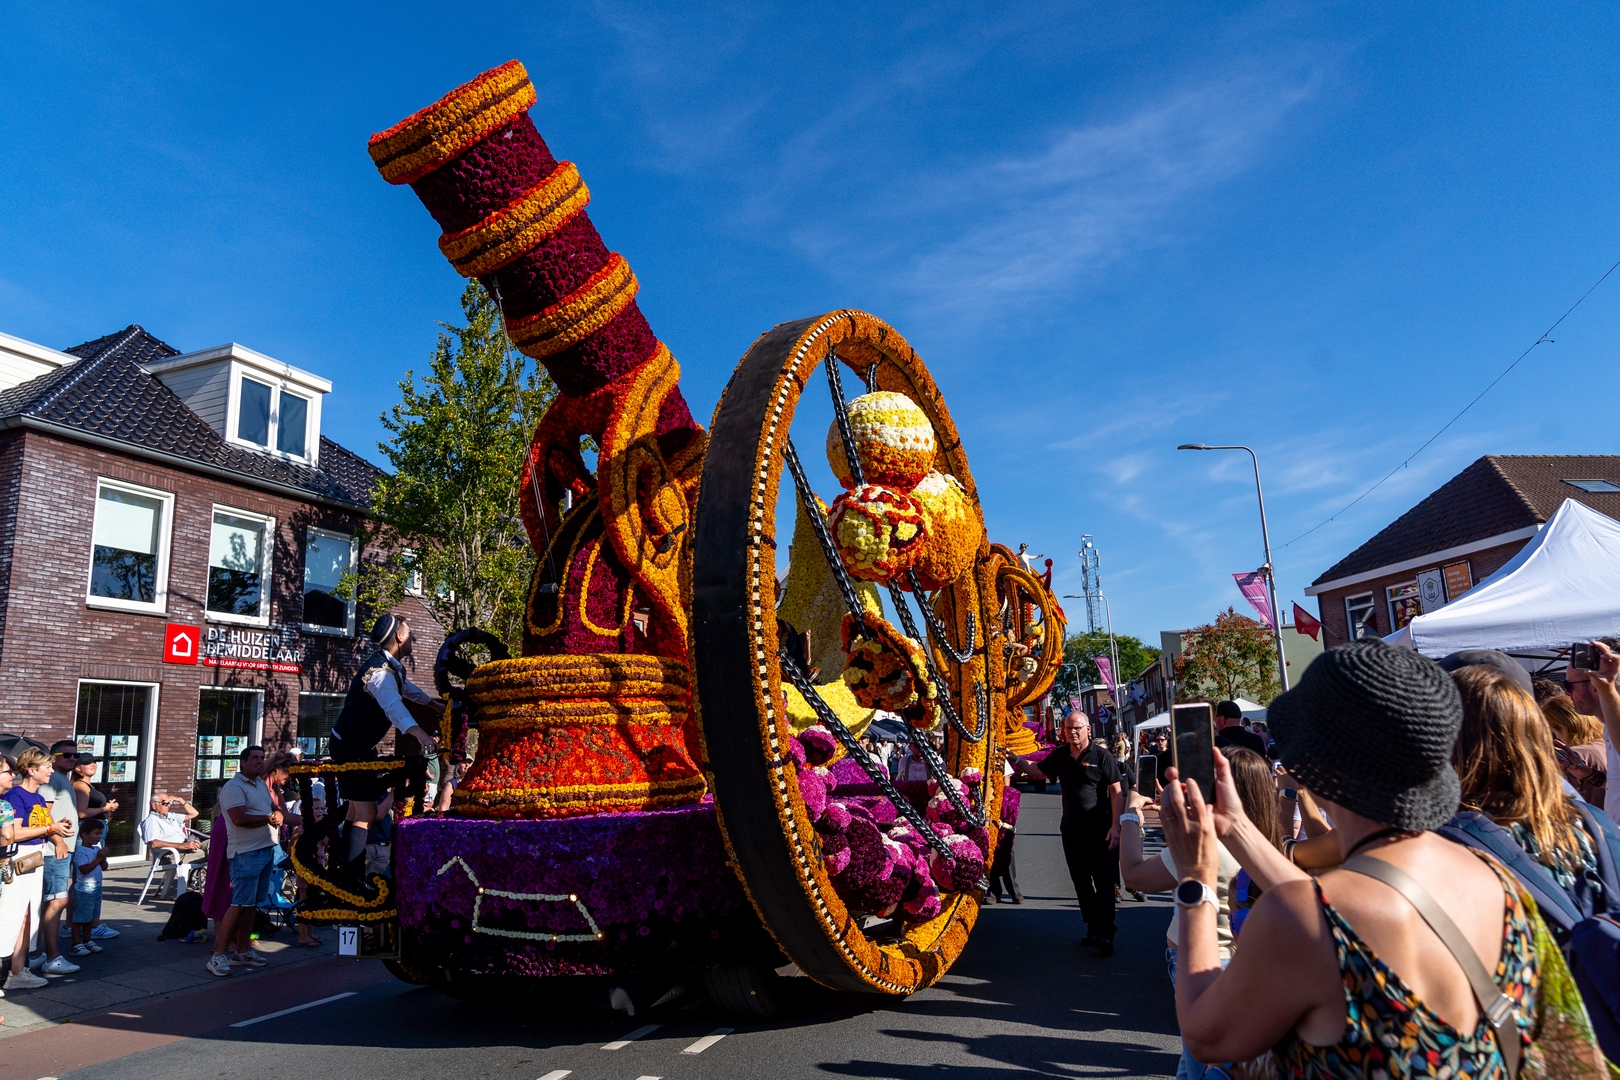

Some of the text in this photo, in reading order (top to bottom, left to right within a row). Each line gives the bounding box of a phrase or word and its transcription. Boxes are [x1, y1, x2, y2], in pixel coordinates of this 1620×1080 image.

[208, 628, 280, 647] DE HUIZEN
[206, 642, 300, 662] BEMIDDELAAR
[342, 930, 356, 945] 17
